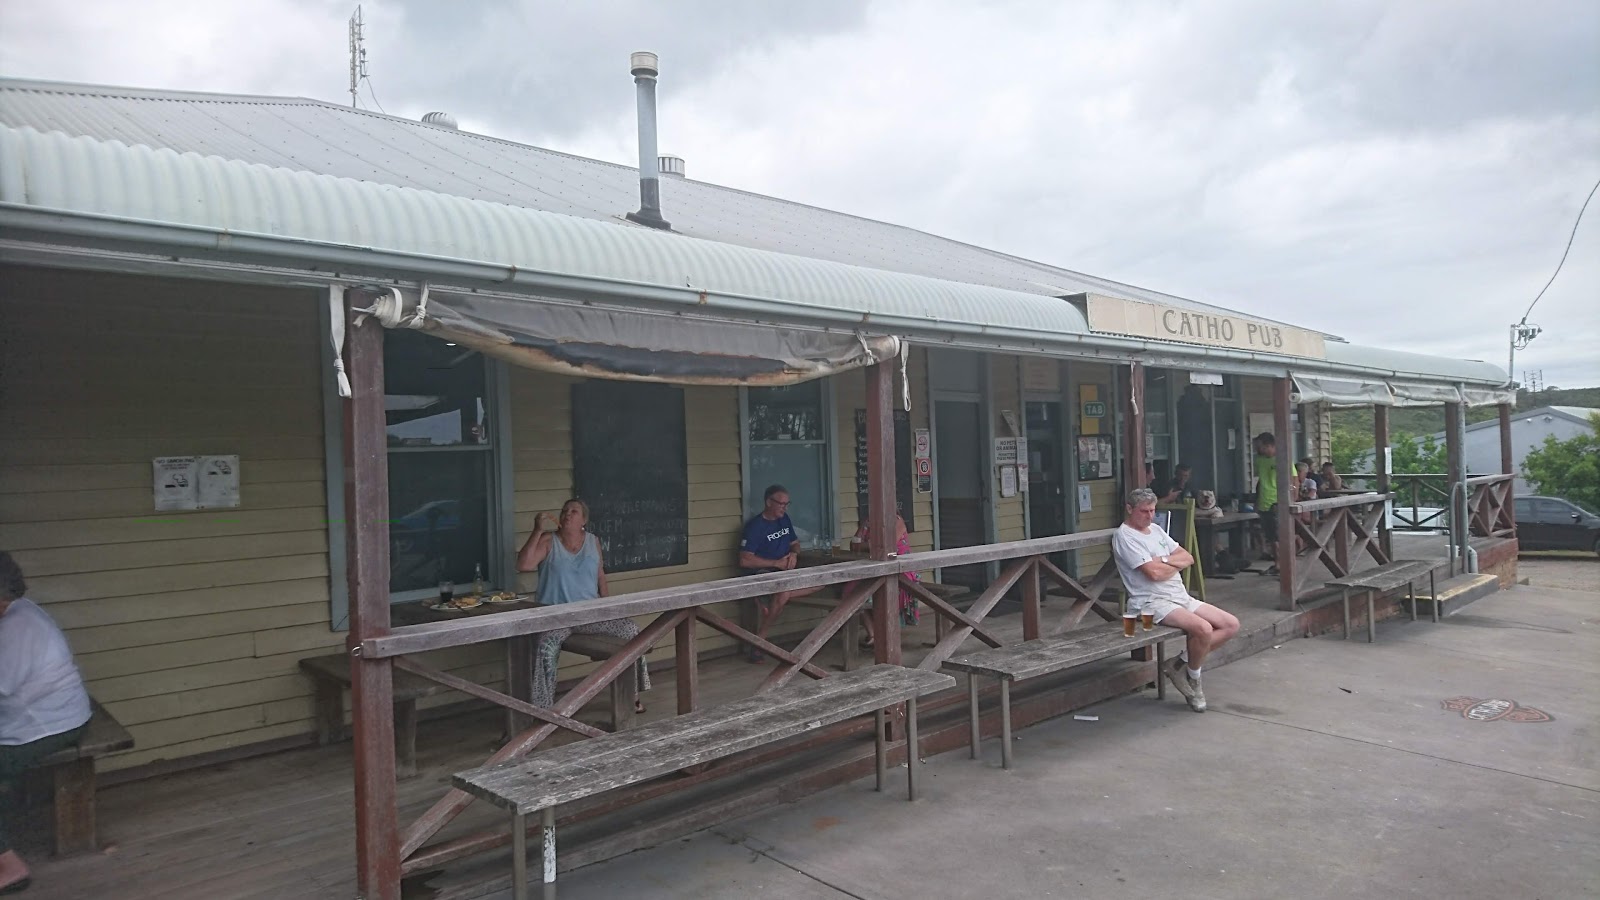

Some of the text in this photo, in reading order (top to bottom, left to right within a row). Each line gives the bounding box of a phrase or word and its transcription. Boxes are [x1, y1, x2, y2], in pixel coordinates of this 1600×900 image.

[1162, 309, 1283, 348] CATHO PUB
[1086, 405, 1103, 415] TAB
